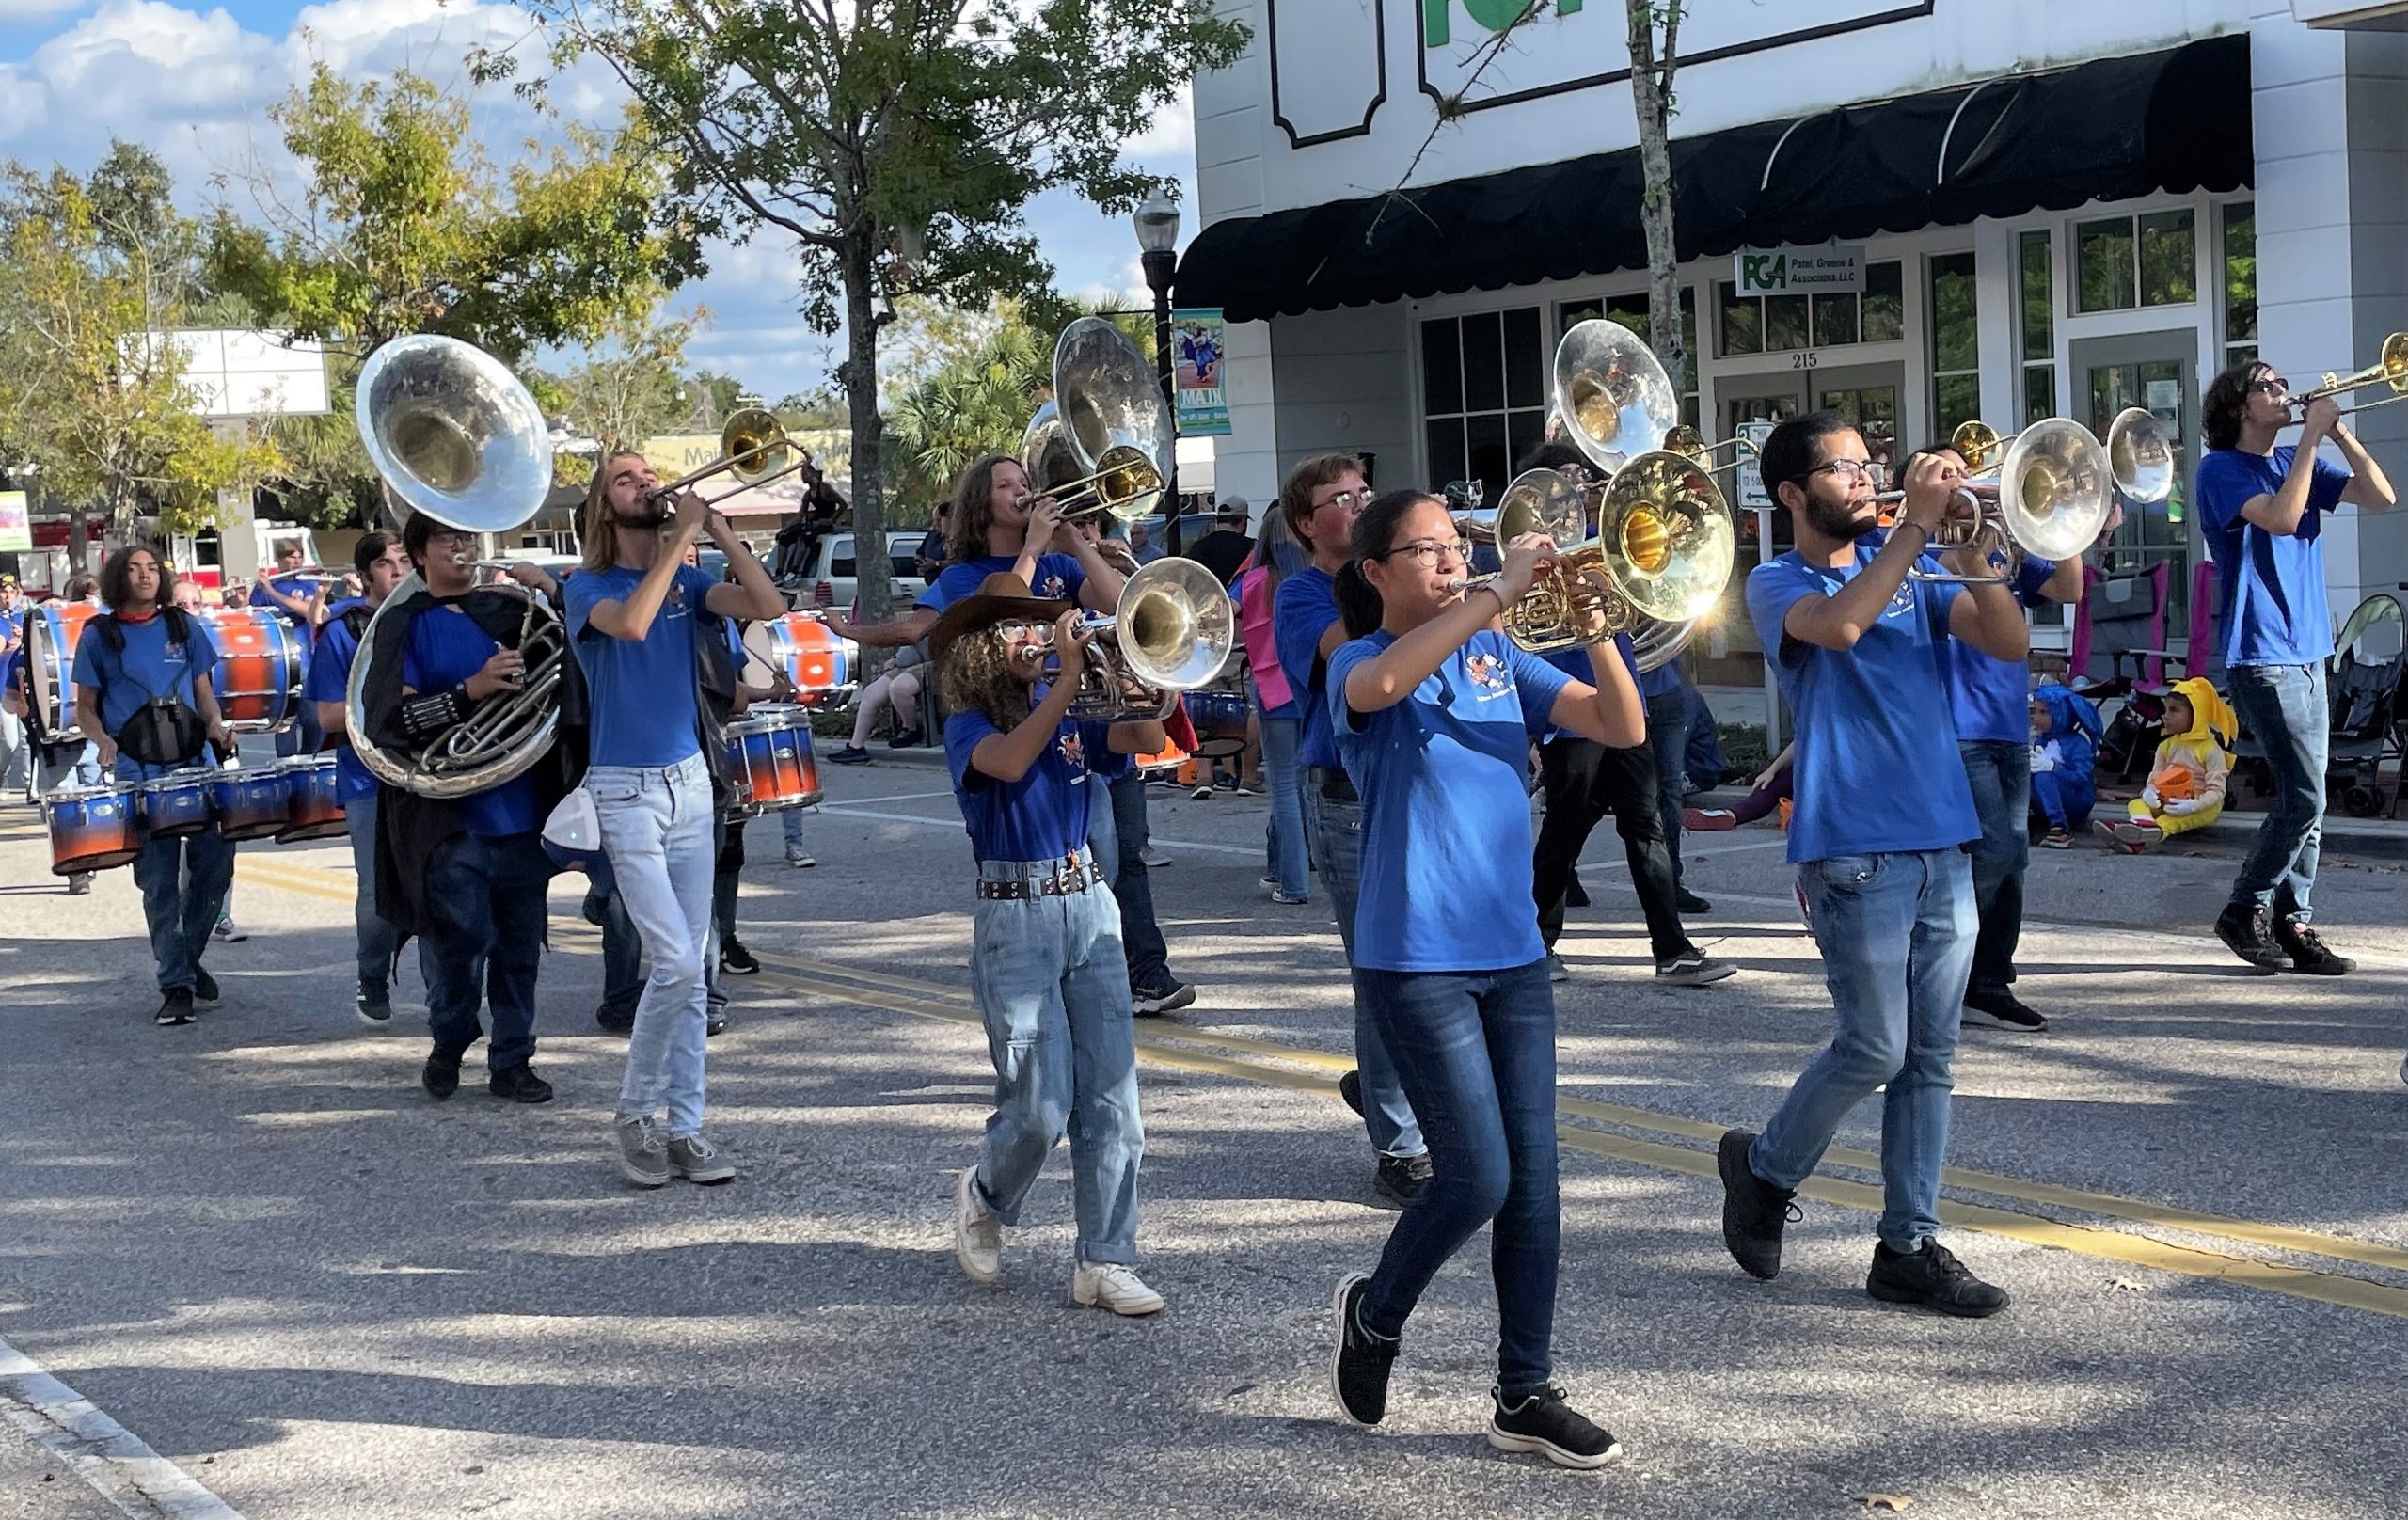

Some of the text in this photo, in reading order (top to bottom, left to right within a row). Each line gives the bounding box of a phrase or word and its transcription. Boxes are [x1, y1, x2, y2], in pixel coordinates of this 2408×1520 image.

[1791, 257, 1854, 269] Patel, Greene &
[1792, 353, 1817, 368] 215
